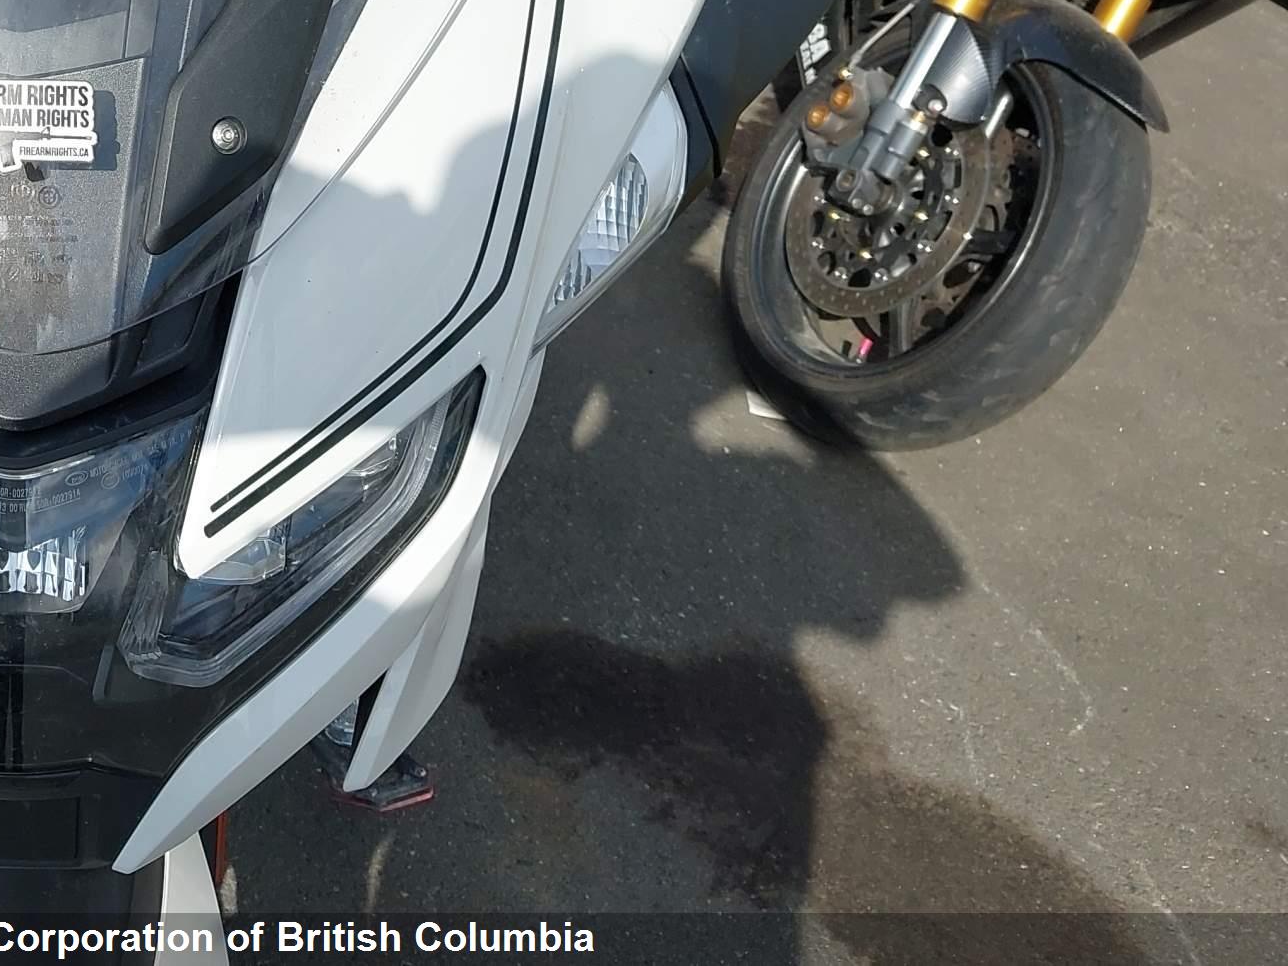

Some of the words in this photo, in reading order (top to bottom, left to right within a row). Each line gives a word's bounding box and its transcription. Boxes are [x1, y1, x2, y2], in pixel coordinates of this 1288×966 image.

[26, 85, 89, 106] RIGHTS
[36, 109, 89, 128] RIGHTS
[19, 146, 89, 158] FIREARMRIGHTS.CA
